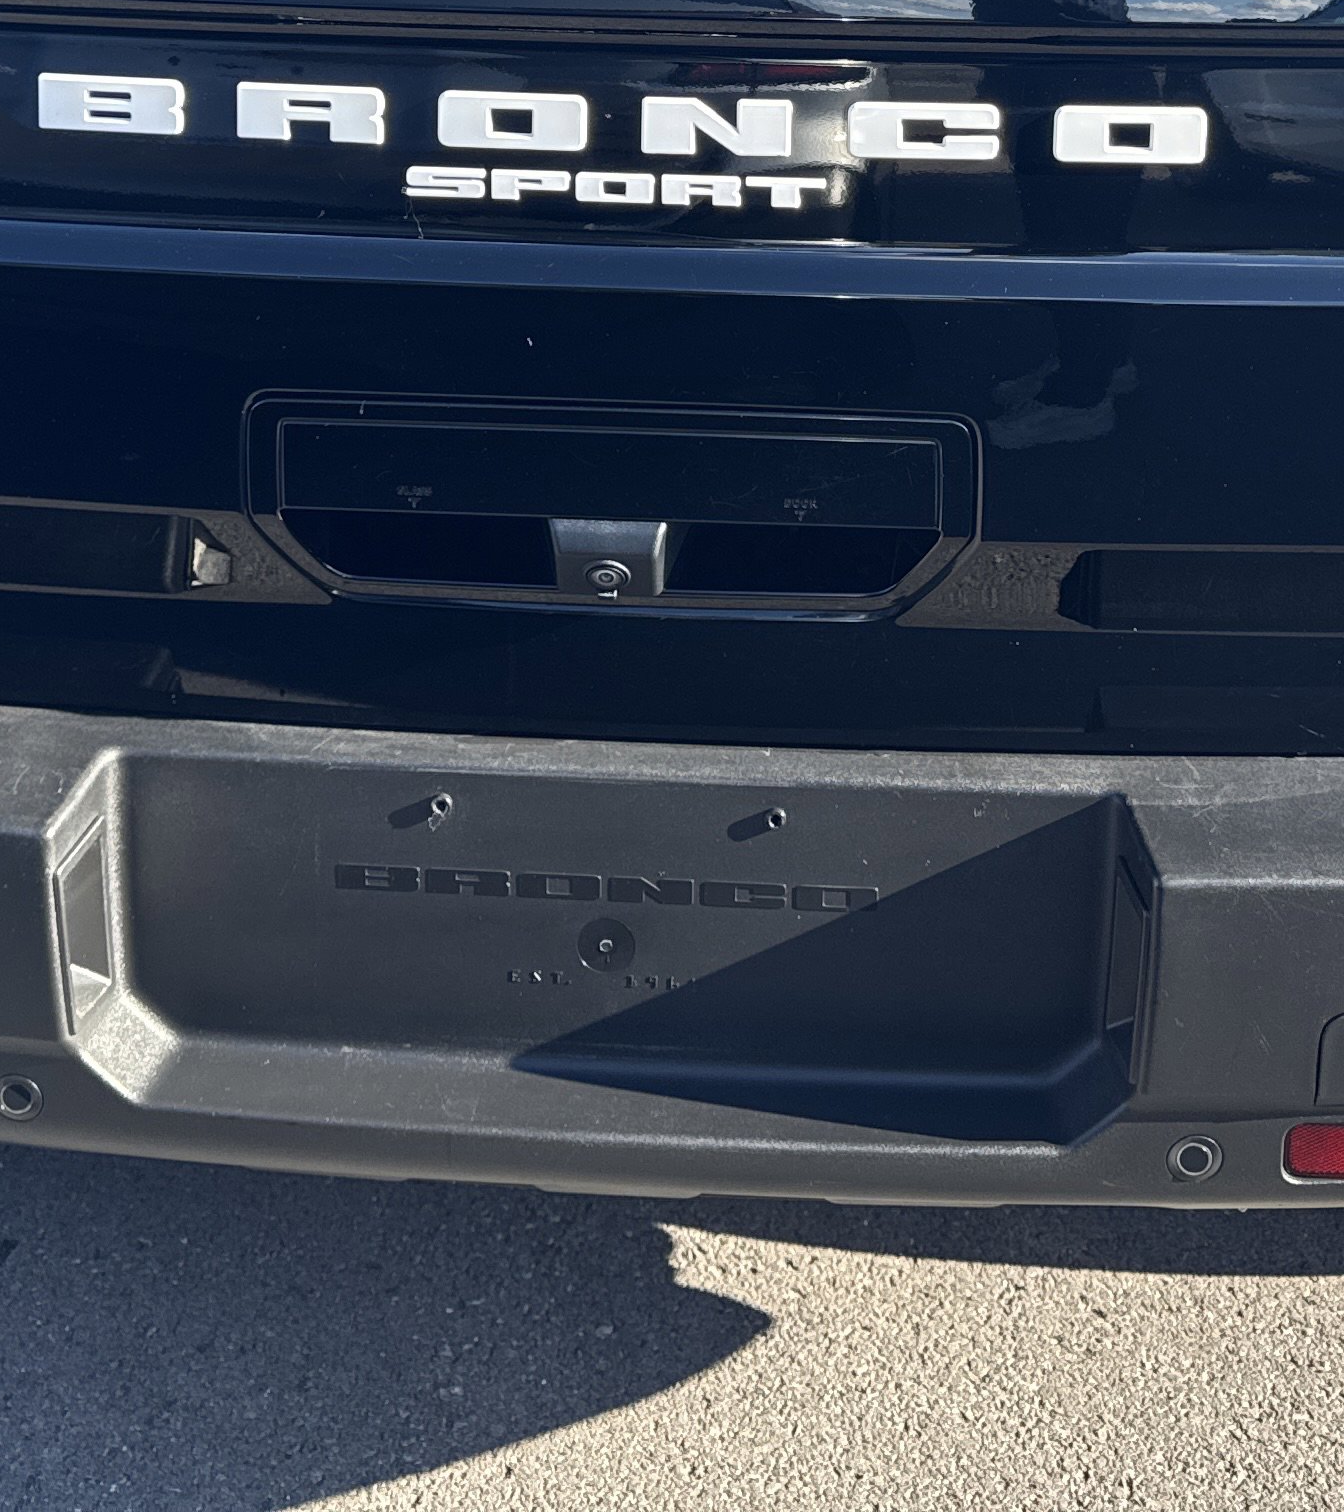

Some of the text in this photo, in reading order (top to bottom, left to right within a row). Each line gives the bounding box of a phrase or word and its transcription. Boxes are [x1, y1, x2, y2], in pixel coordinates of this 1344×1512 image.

[38, 72, 1208, 165] BRONCO
[404, 165, 829, 209] SPORT
[335, 863, 880, 913] BRONCO
